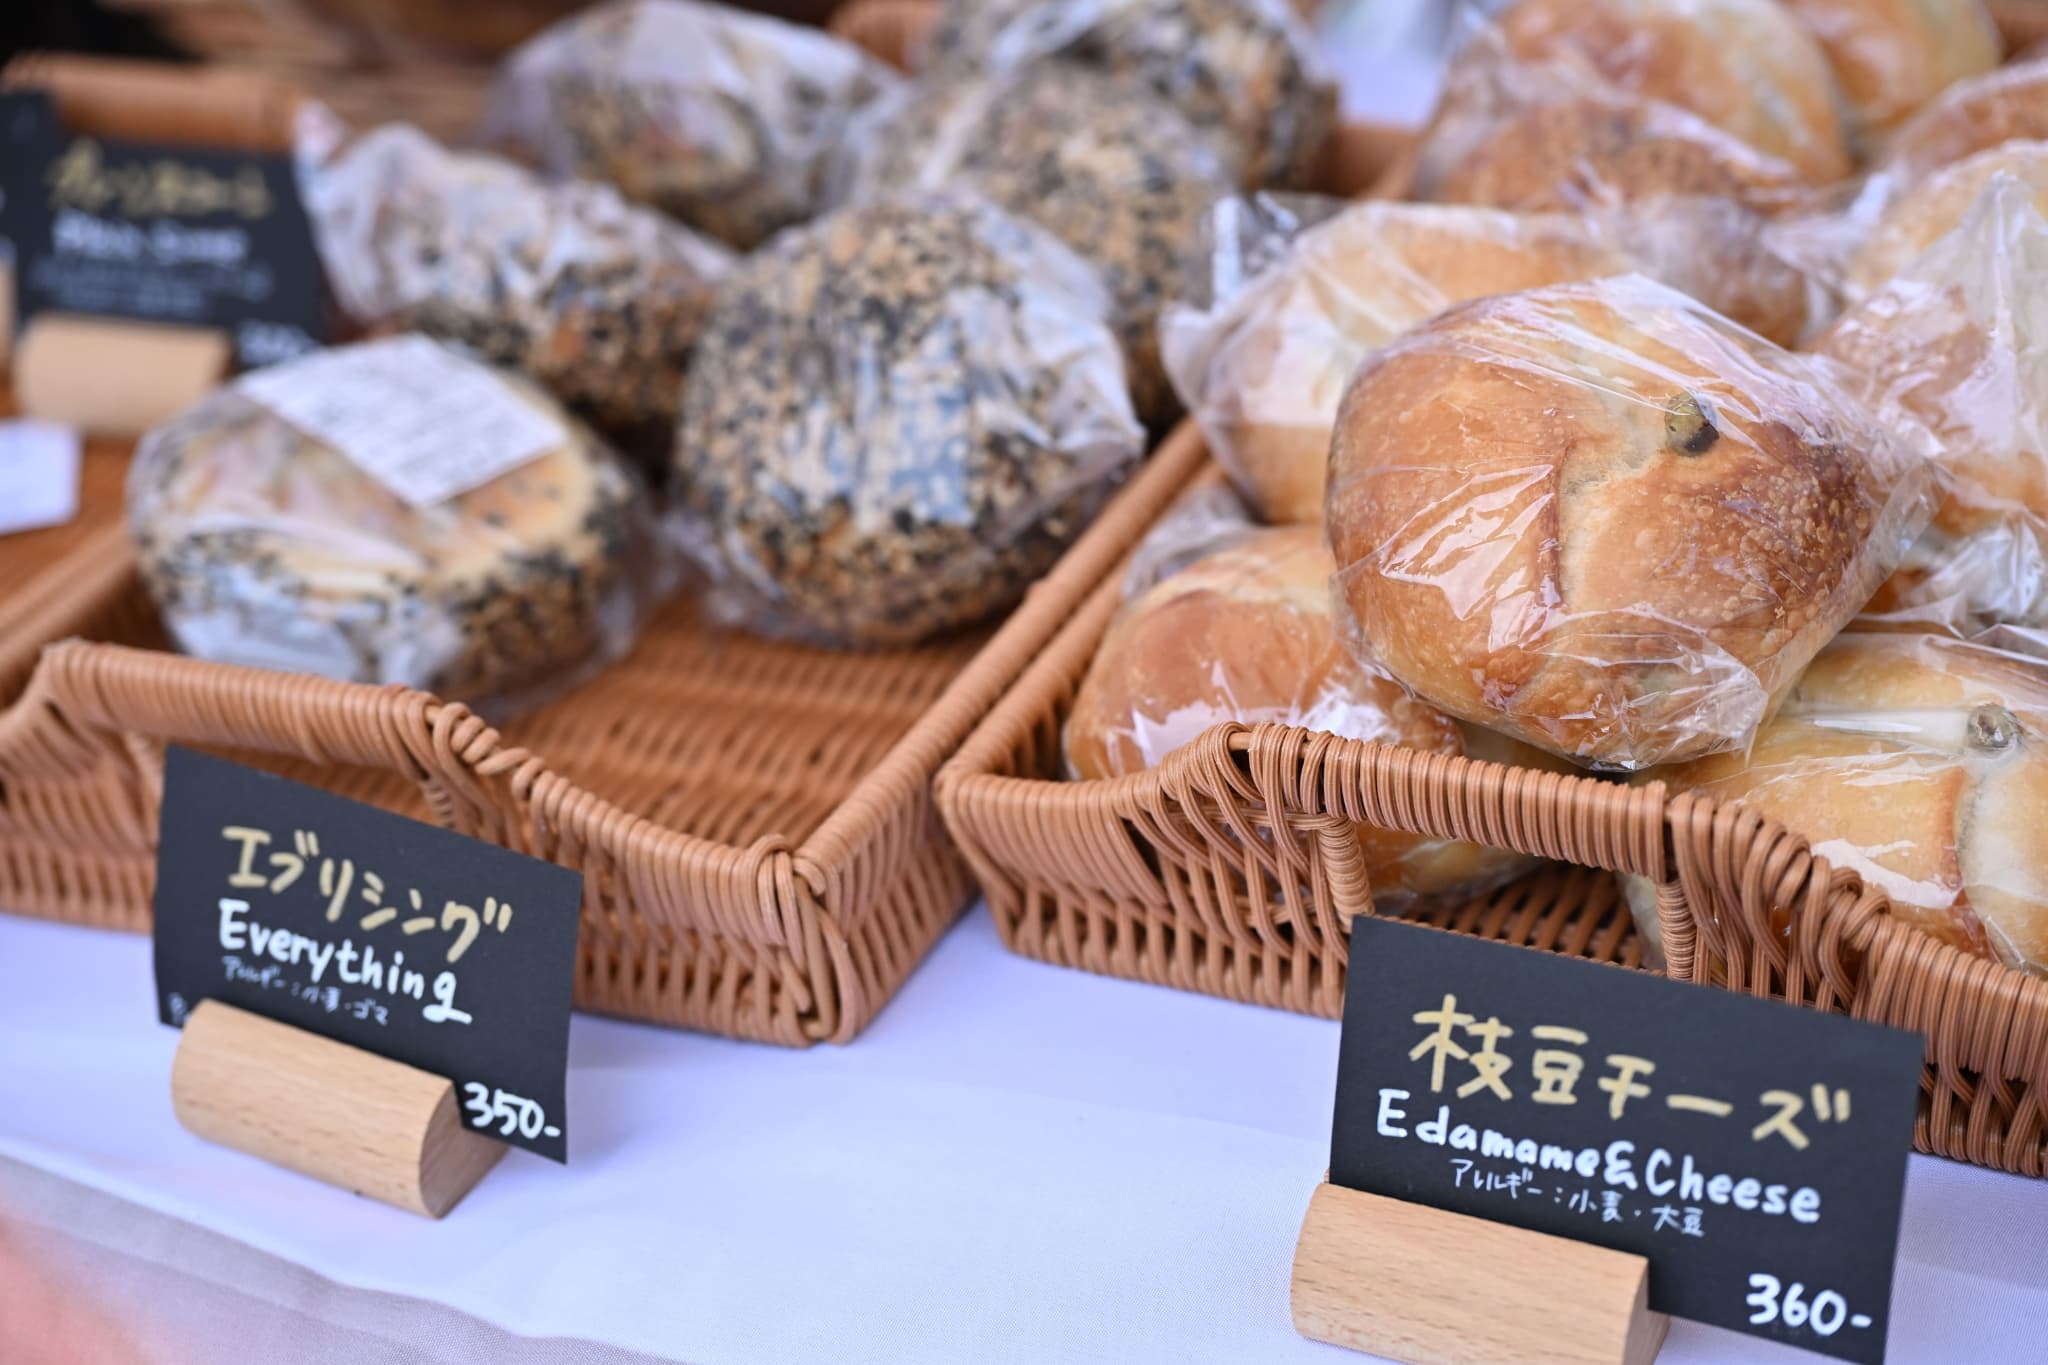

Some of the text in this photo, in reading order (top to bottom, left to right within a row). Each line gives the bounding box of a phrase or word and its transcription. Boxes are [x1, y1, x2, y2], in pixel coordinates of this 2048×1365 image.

[222, 825, 512, 963] エブリシング
[219, 898, 473, 1024] Everything
[464, 1082, 561, 1139] 350-
[1408, 993, 1851, 1151] 枝豆チーズ
[1746, 1272, 1874, 1336] 360-
